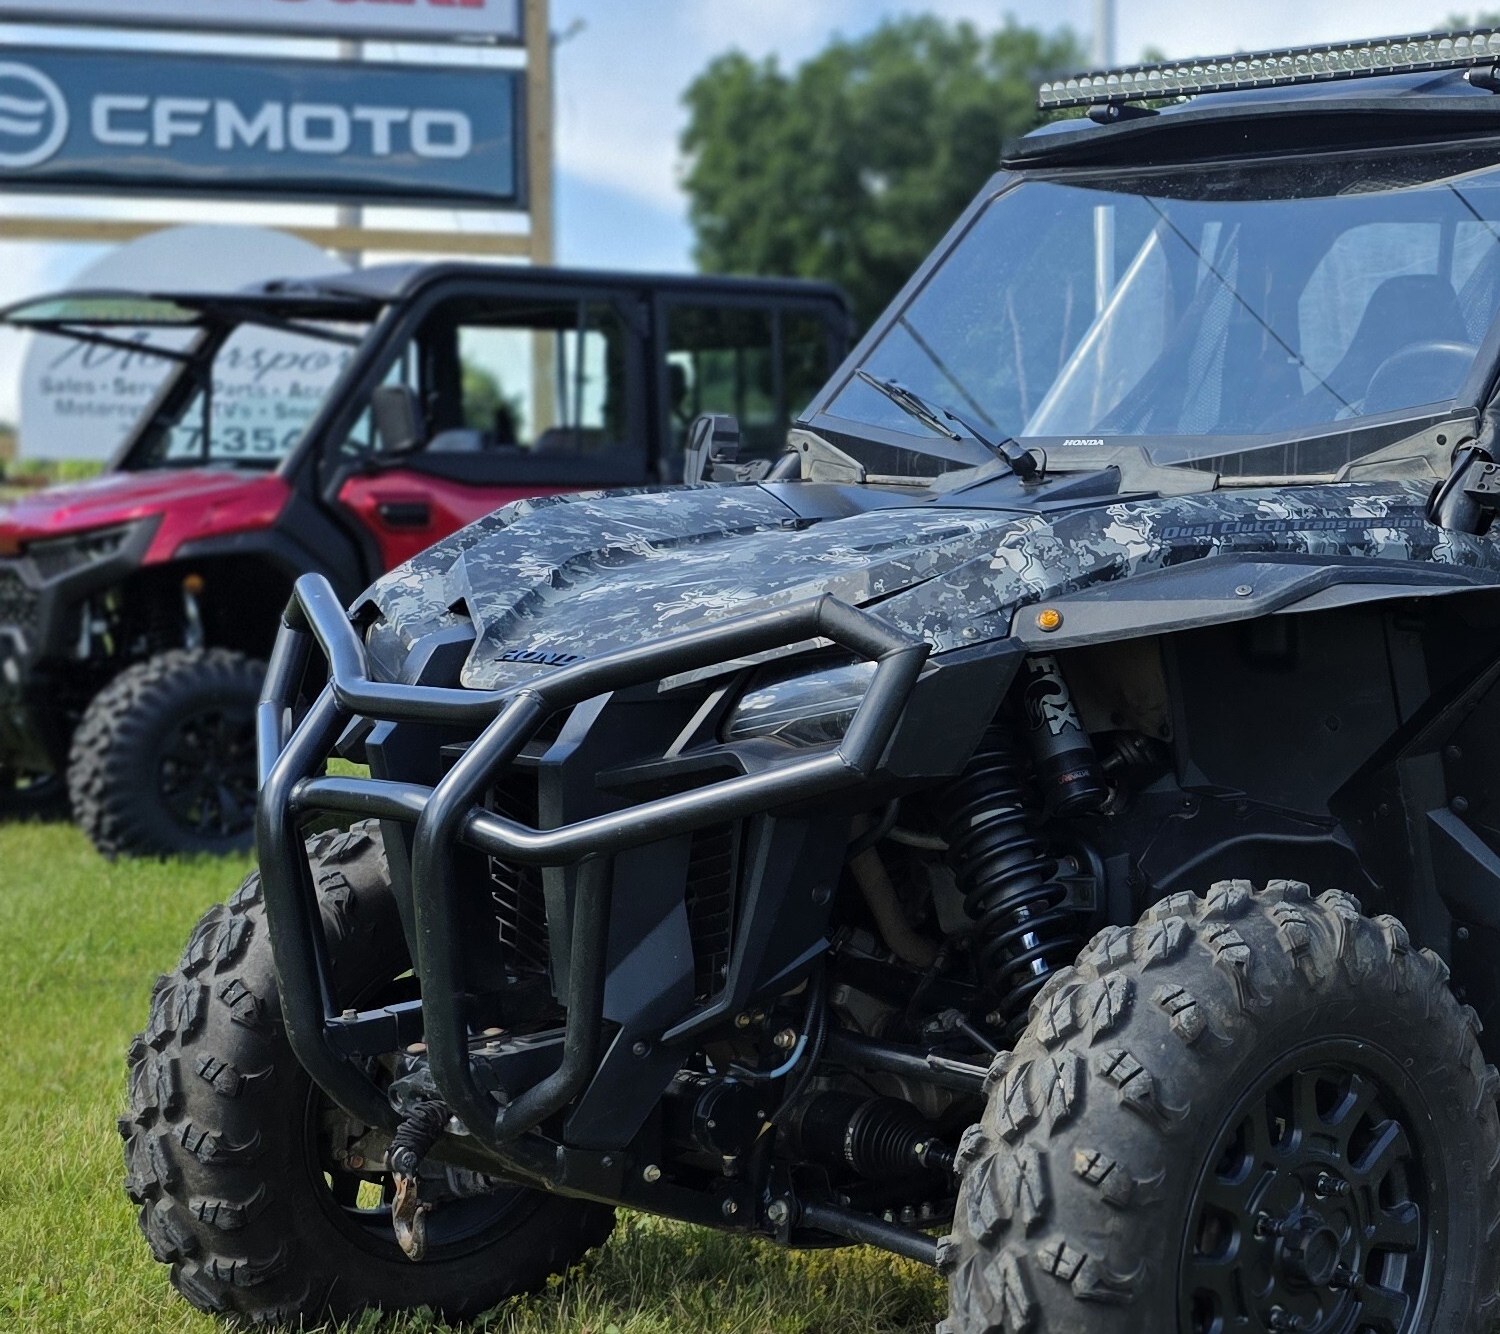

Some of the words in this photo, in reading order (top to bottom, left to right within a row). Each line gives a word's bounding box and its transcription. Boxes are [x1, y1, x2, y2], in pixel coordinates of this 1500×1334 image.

[91, 94, 472, 158] CFMOTO
[1162, 524, 1212, 540] Dual
[1220, 521, 1287, 535] Clutch
[1291, 517, 1424, 531] Transmission
[496, 649, 586, 666] HOND
[1025, 655, 1082, 735] FOX
